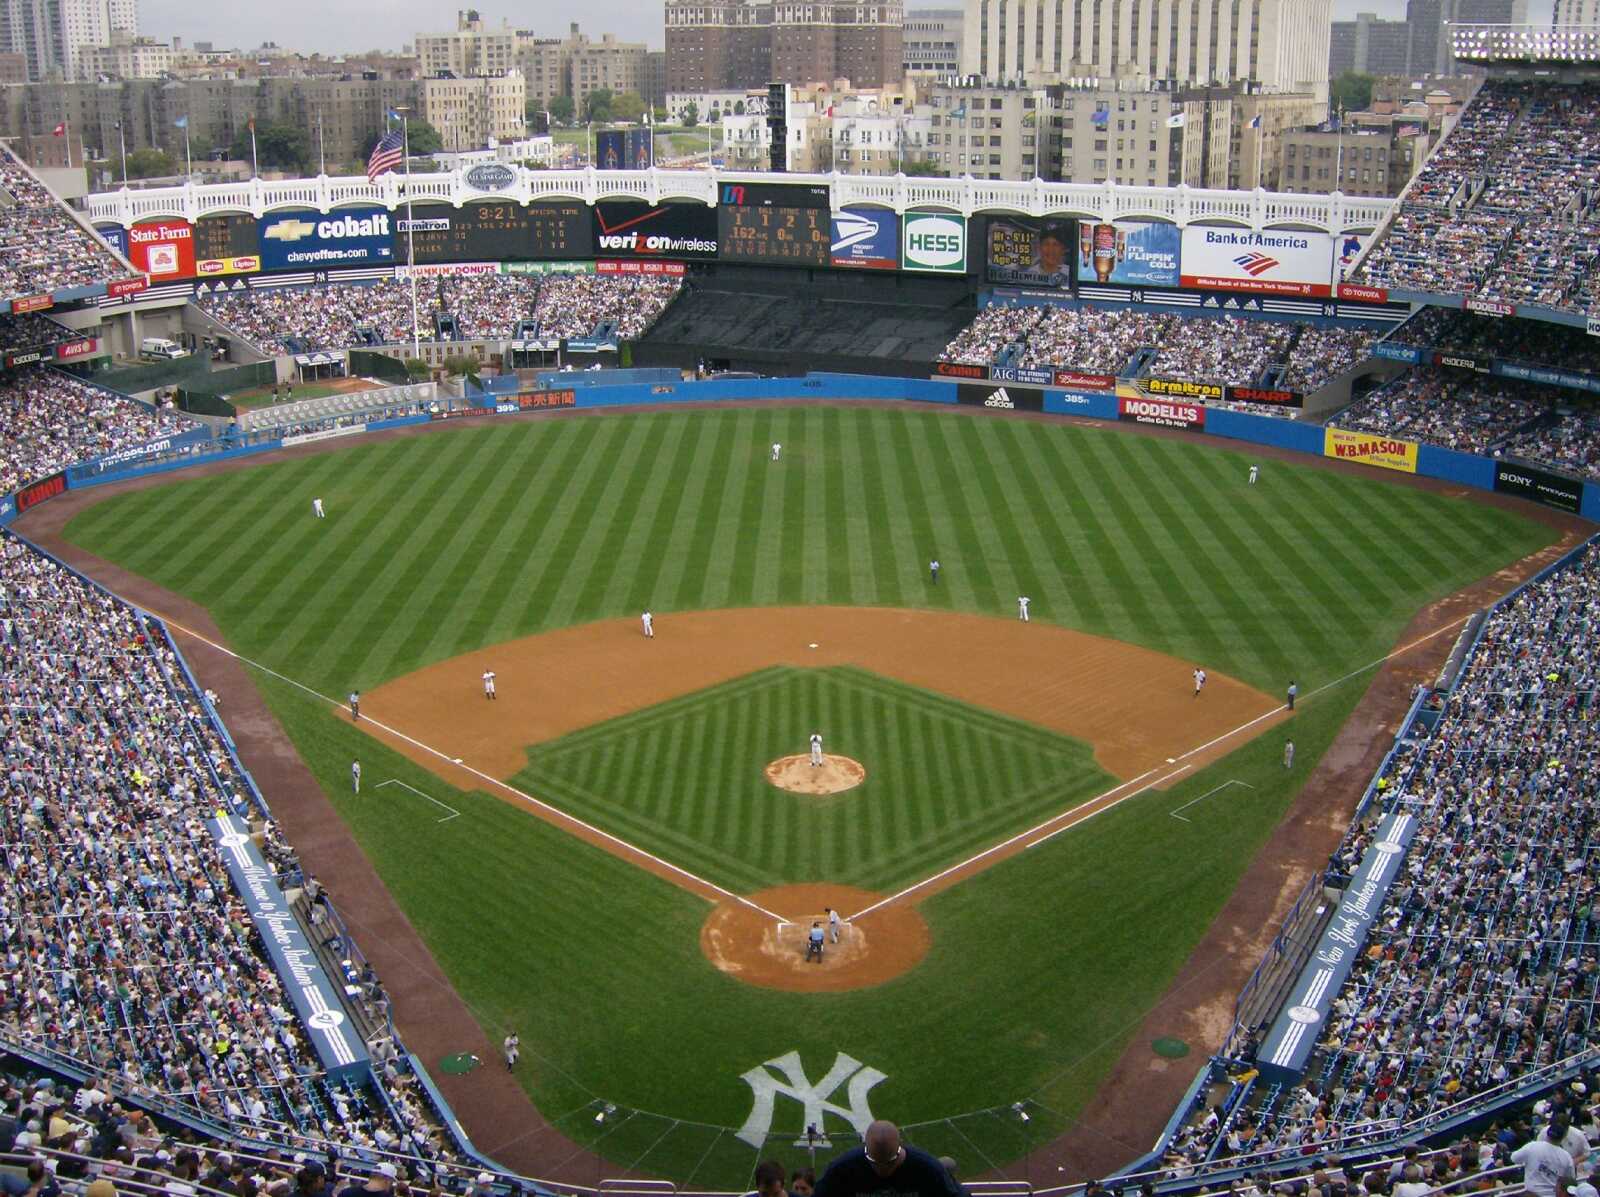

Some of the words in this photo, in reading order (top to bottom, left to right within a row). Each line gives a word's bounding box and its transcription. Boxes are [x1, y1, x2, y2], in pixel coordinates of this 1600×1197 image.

[479, 207, 516, 219] 3:21
[318, 215, 389, 239] cobalt
[786, 215, 795, 228] 2
[130, 229, 158, 242] State
[159, 226, 190, 240] Farm
[1206, 231, 1238, 245] Bank
[1240, 232, 1254, 246] of
[1255, 234, 1308, 249] America
[909, 233, 959, 252] HESS
[288, 248, 367, 263] chevyoffers.com
[201, 263, 223, 272] Lipton
[234, 260, 256, 268] Lipton
[456, 265, 496, 275] DONUTS
[122, 281, 143, 292] TOYOTA
[1353, 289, 1380, 299] TOYOTA
[1466, 300, 1512, 315] MODELL'S
[65, 343, 82, 356] AVIS
[937, 362, 982, 377] Canon
[1441, 356, 1475, 369] KYOCERA
[993, 368, 1014, 380] AIG
[1059, 374, 1107, 386] Budweiser
[1150, 380, 1222, 397] Armitron
[1233, 388, 1293, 402] SHARP
[496, 404, 514, 413] 399
[985, 398, 1014, 409] adidas
[1126, 400, 1198, 421] MODELL'S
[99, 439, 171, 471] yankees.com
[1499, 472, 1533, 487] SONY
[18, 477, 65, 513] Canon
[242, 865, 270, 901] Welcome
[1342, 881, 1378, 920] Yankees
[254, 911, 298, 944] Yankee
[1328, 916, 1360, 948] York
[282, 945, 317, 985] Stadium
[1317, 946, 1344, 972] New
[734, 1050, 888, 1149] NY
